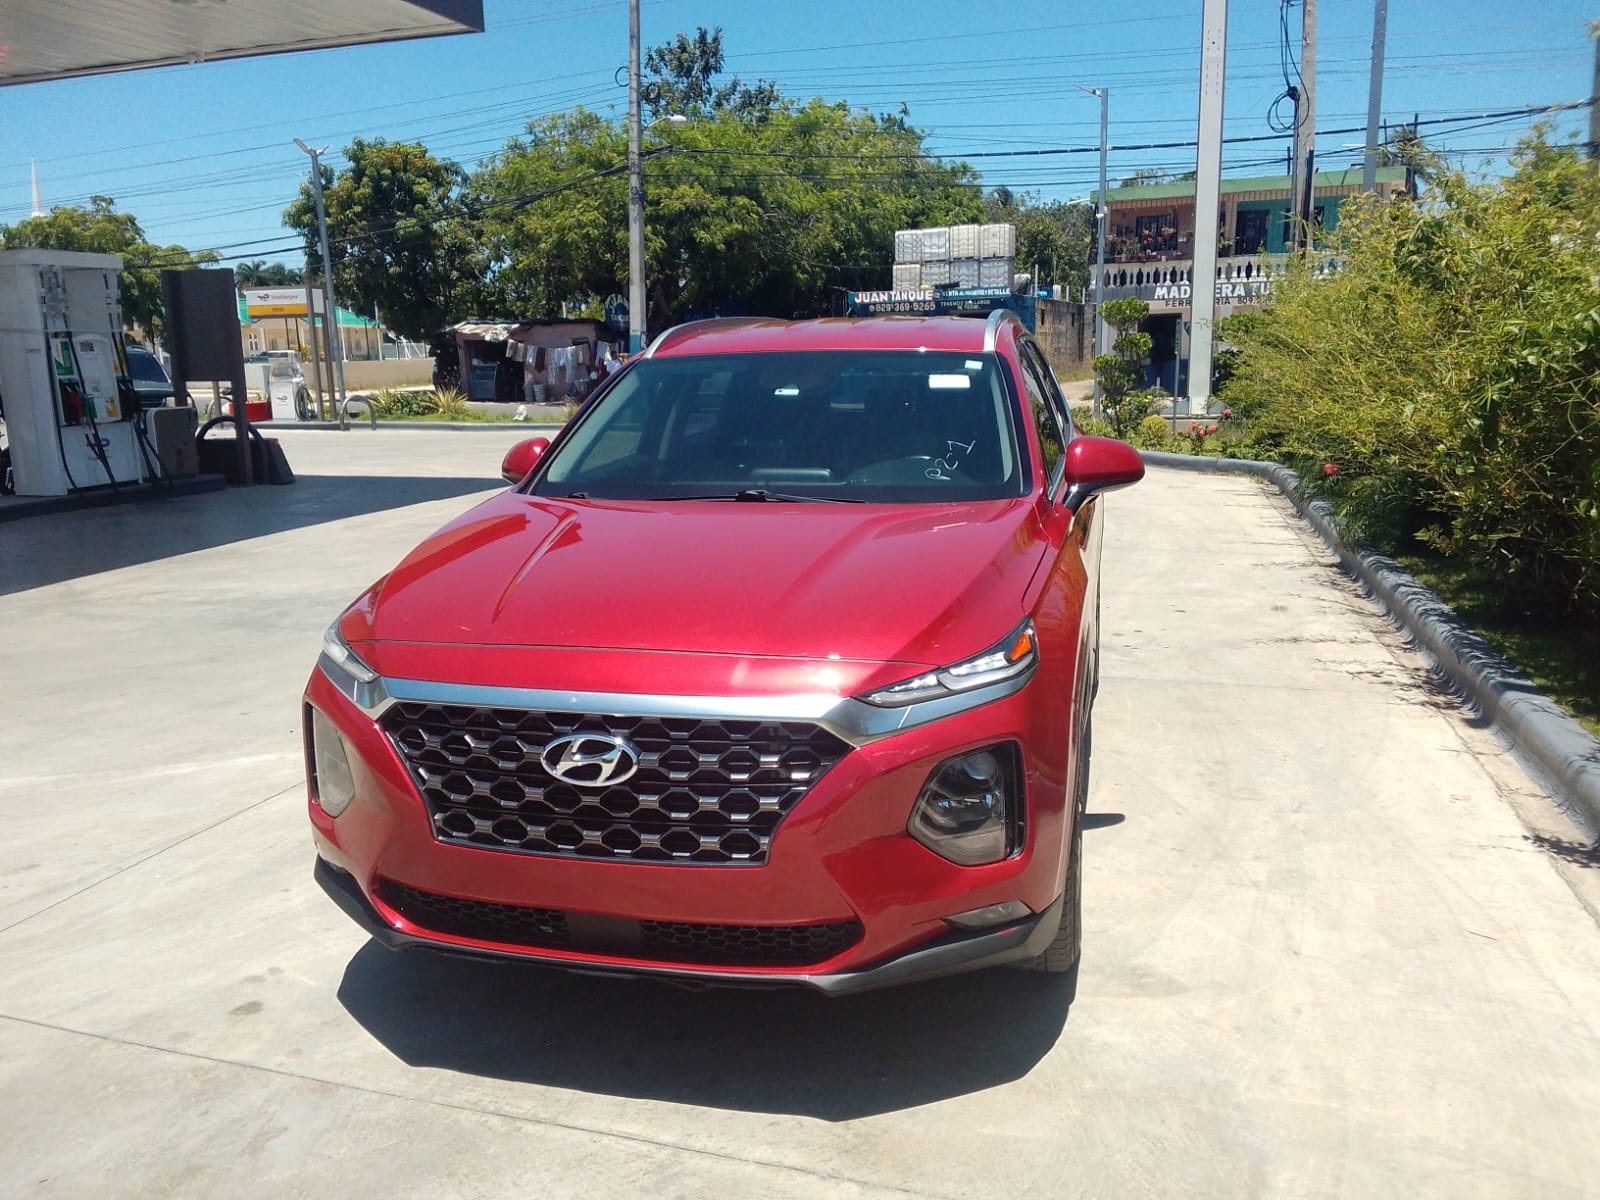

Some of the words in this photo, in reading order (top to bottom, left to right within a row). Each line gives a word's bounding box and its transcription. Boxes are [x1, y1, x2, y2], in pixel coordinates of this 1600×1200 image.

[854, 291, 888, 303] JUAN
[889, 290, 934, 302] TANQUE
[1154, 282, 1246, 300] MADERA
[1165, 298, 1231, 308] FERRRIA
